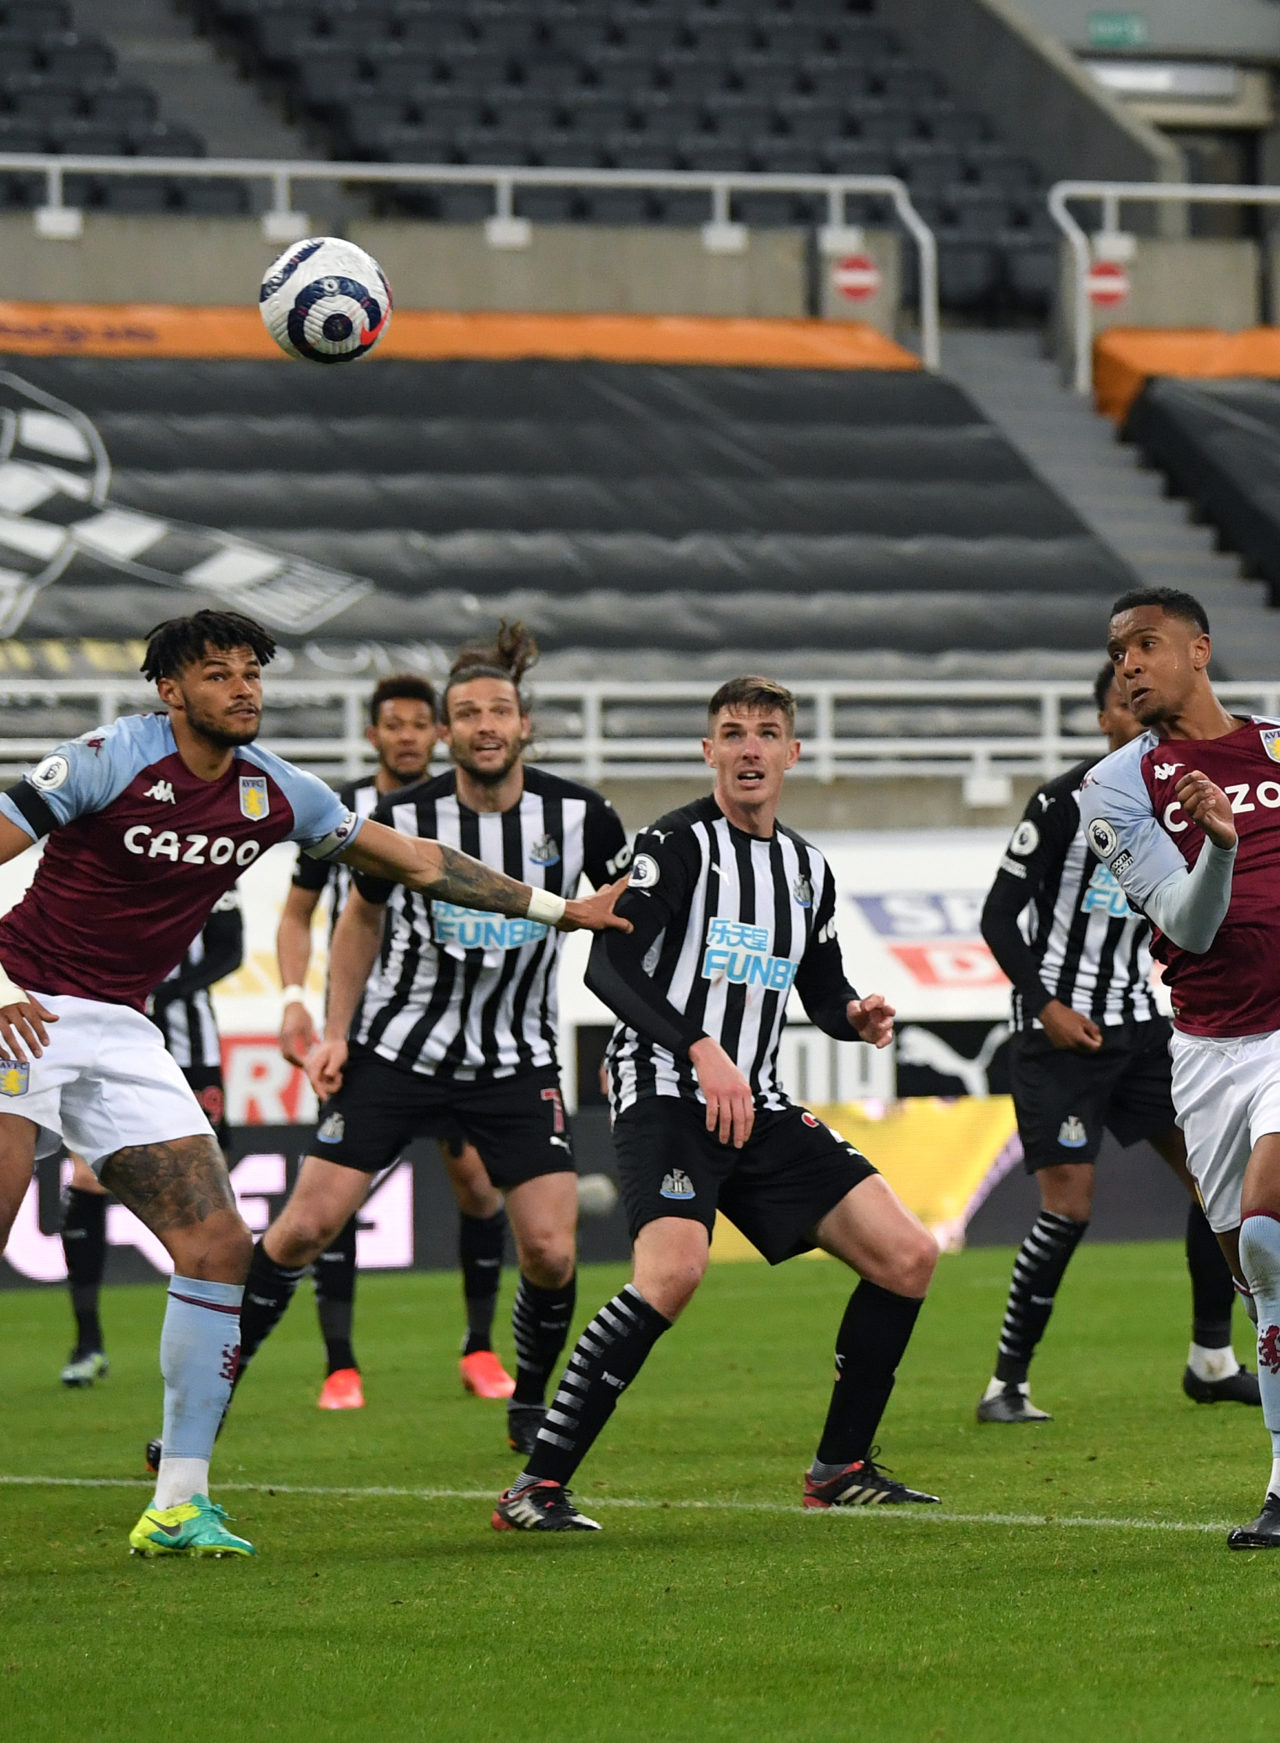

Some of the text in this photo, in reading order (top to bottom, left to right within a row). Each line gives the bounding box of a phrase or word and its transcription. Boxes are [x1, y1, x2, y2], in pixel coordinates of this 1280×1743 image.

[123, 824, 260, 867] CAZOO
[437, 921, 548, 947] FUN88
[540, 1088, 565, 1133] 7
